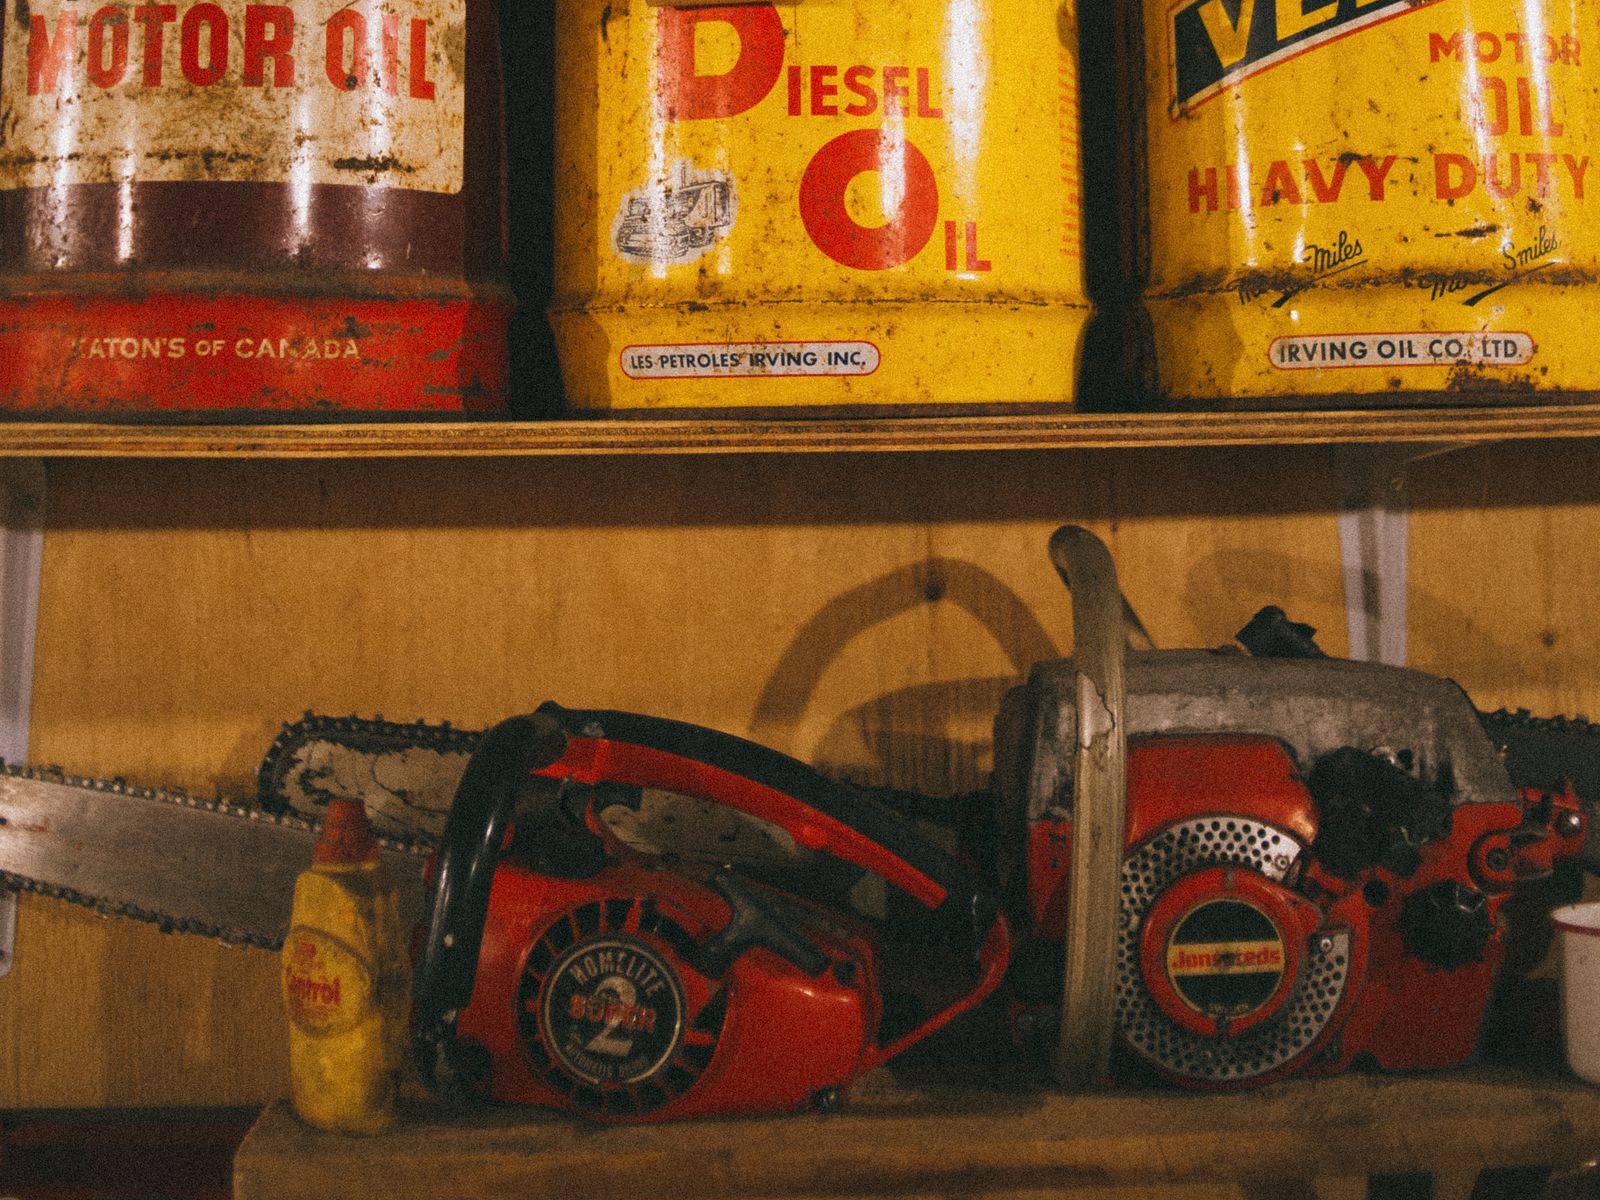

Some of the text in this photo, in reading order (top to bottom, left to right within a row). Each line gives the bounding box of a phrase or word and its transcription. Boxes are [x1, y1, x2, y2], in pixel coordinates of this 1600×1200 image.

[26, 2, 436, 101] MOTOR OIL
[656, 4, 943, 123] DIESEL
[1428, 31, 1583, 67] MOTOR
[1470, 76, 1566, 137] OIL
[1433, 152, 1590, 200] DUTY
[798, 128, 992, 272] OIL
[1303, 230, 1364, 276] Miles
[195, 340, 225, 356] OF
[234, 337, 360, 360] CANADA
[631, 351, 867, 369] LES PETROLES IRVING INC.
[1279, 340, 1368, 363] IRVING
[1377, 340, 1418, 359] OIL
[1481, 337, 1523, 359] LTD.
[569, 951, 664, 996] HOMELITE
[1171, 947, 1281, 970] Jonreds
